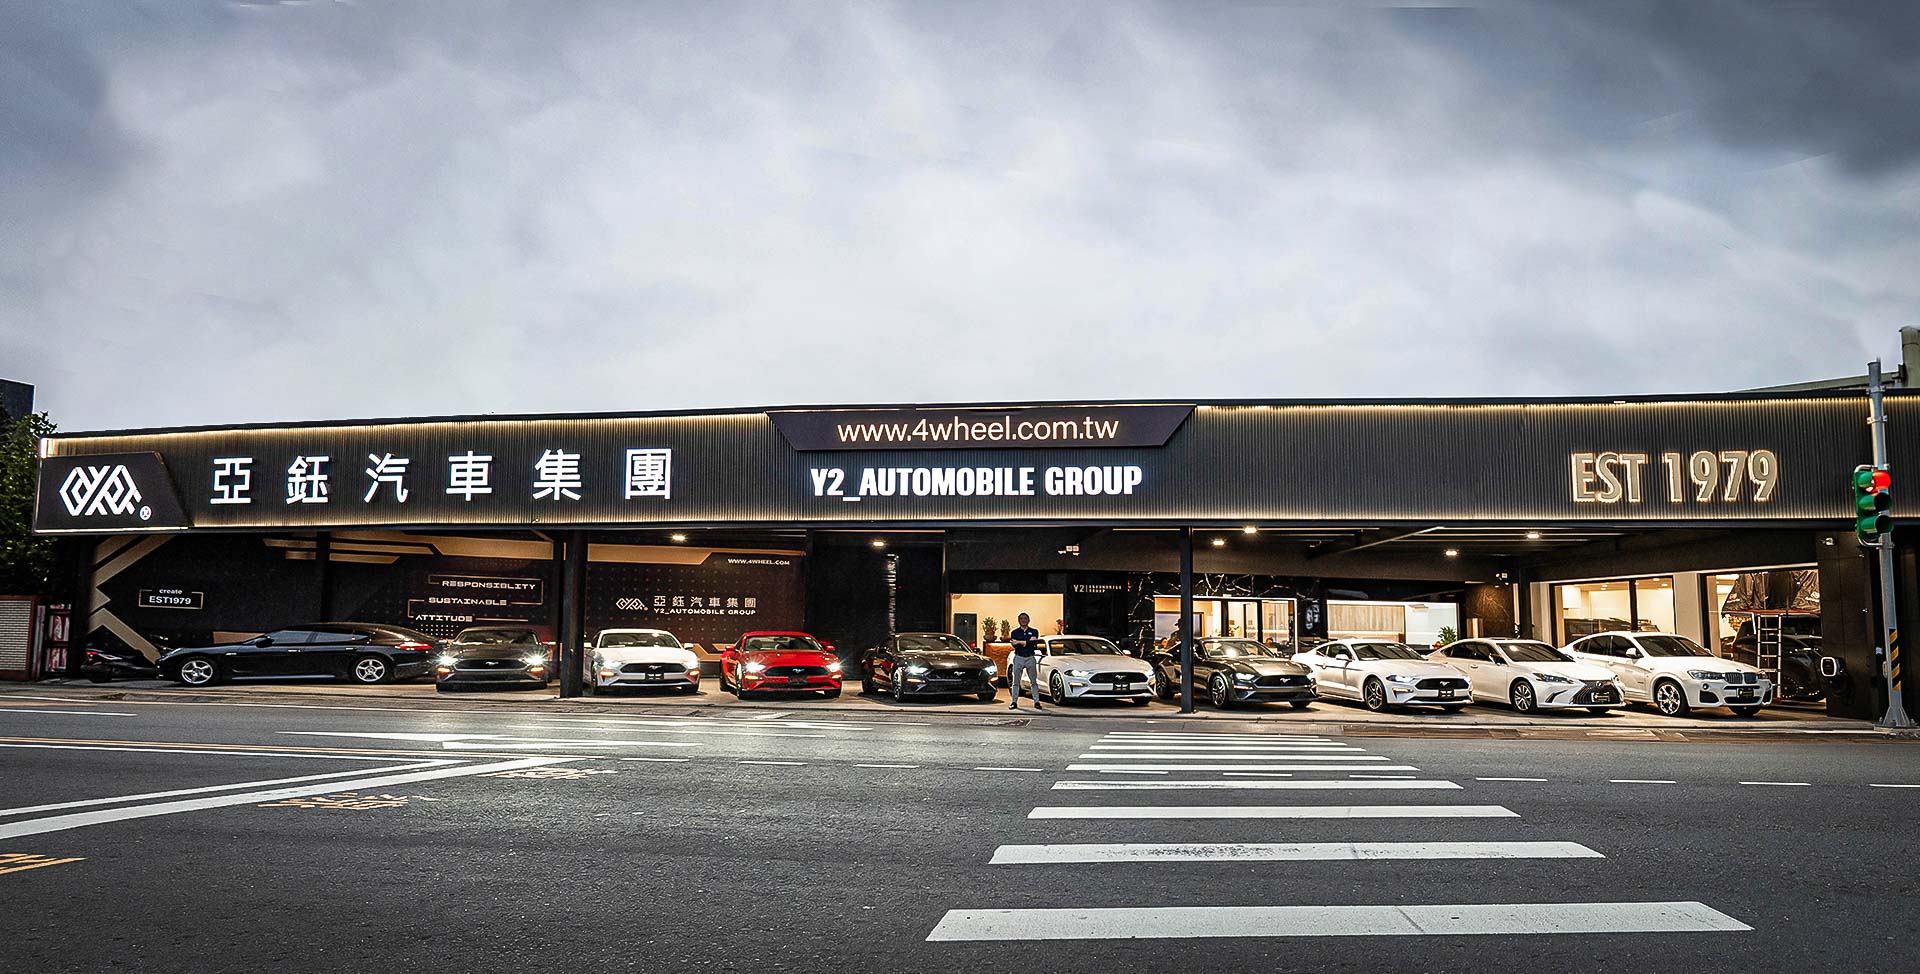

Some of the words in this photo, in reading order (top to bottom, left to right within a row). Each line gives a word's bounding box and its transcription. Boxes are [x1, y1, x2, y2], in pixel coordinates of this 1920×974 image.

[837, 415, 1119, 442] www.4wheel.com.tw
[210, 447, 673, 504] 亞鈺汽車集團
[810, 466, 1035, 501] Y2_AUTOMOBILE
[1044, 465, 1142, 495] GROUP
[1570, 451, 1648, 503] EST
[1661, 449, 1778, 503] 1979
[148, 595, 192, 605] EST1979
[428, 597, 507, 606] SUSTAINABLE
[415, 614, 473, 623] ATTITUDE
